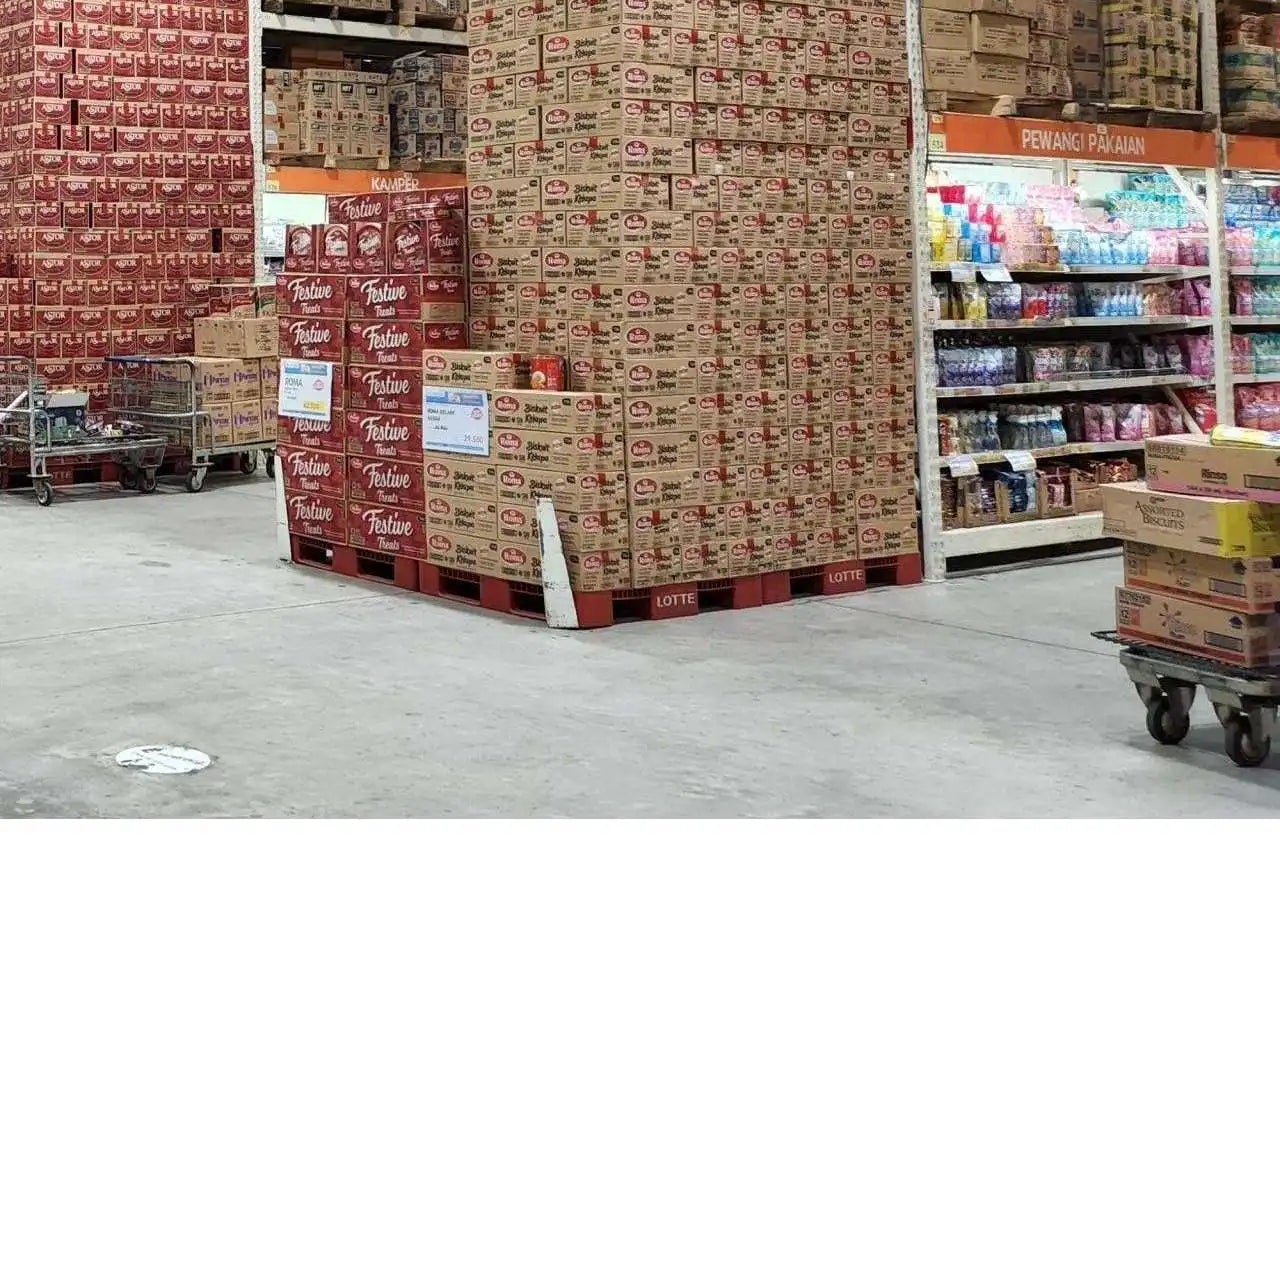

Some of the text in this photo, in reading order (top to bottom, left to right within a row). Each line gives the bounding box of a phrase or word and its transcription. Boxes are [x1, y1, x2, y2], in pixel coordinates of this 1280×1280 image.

[43, 0, 64, 9] ASTOR
[82, 4, 103, 13] ASTOR
[121, 32, 140, 41] ASTOR
[190, 36, 209, 45] ASTOR
[223, 39, 242, 48] ASTOR
[43, 51, 65, 60] ASTOR
[84, 55, 105, 64] ASTOR
[156, 84, 176, 93] ASTOR
[191, 85, 210, 94] ASTOR
[41, 103, 64, 112] ASTOR
[86, 105, 107, 115] ASTOR
[158, 134, 178, 142] ASTOR
[193, 134, 212, 143] ASTOR
[226, 136, 245, 145] ASTOR
[1022, 129, 1145, 155] PEWANGI PAKAIAN
[40, 155, 62, 164] ASTOR
[113, 157, 134, 167] ASTOR
[67, 183, 88, 191] ASTOR
[127, 184, 147, 192] ASTOR
[162, 184, 182, 192] ASTOR
[228, 184, 247, 193] ASTOR
[371, 177, 419, 191] KAMPER
[339, 197, 383, 219] Festive
[42, 233, 64, 241] ASTOR
[80, 234, 101, 243] ASTOR
[230, 233, 249, 242] ASTOR
[41, 260, 64, 268] ASTOR
[80, 260, 101, 268] ASTOR
[116, 259, 137, 268] ASTOR
[288, 278, 332, 302] Festive
[361, 279, 407, 305] Festive
[184, 309, 204, 317] ASTOR
[301, 303, 321, 314] Treats
[374, 305, 395, 317] Treats
[44, 312, 65, 321] ASTOR
[80, 312, 101, 321] ASTOR
[116, 311, 137, 319] ASTOR
[290, 321, 331, 345] Festive
[362, 325, 410, 350] Festive
[145, 336, 165, 344] ASTOR
[301, 347, 320, 358] Treats
[376, 352, 398, 364] Treats
[44, 365, 66, 374] ASTOR
[80, 364, 102, 372] ASTOR
[285, 378, 303, 388] ROMA
[362, 371, 411, 396] Festive
[377, 398, 399, 410] Treats
[360, 416, 410, 442] Festive
[301, 434, 321, 446] Treats
[374, 444, 397, 456] Treats
[288, 451, 331, 477] Festive
[363, 463, 412, 489] Festive
[301, 478, 320, 490] Treats
[377, 491, 398, 503] Treats
[290, 496, 333, 522] Festive
[362, 508, 413, 536] Festive
[303, 522, 323, 535] Treats
[378, 537, 400, 551] Treats
[829, 570, 864, 584] LOTTE
[656, 592, 695, 607] LOTTE
